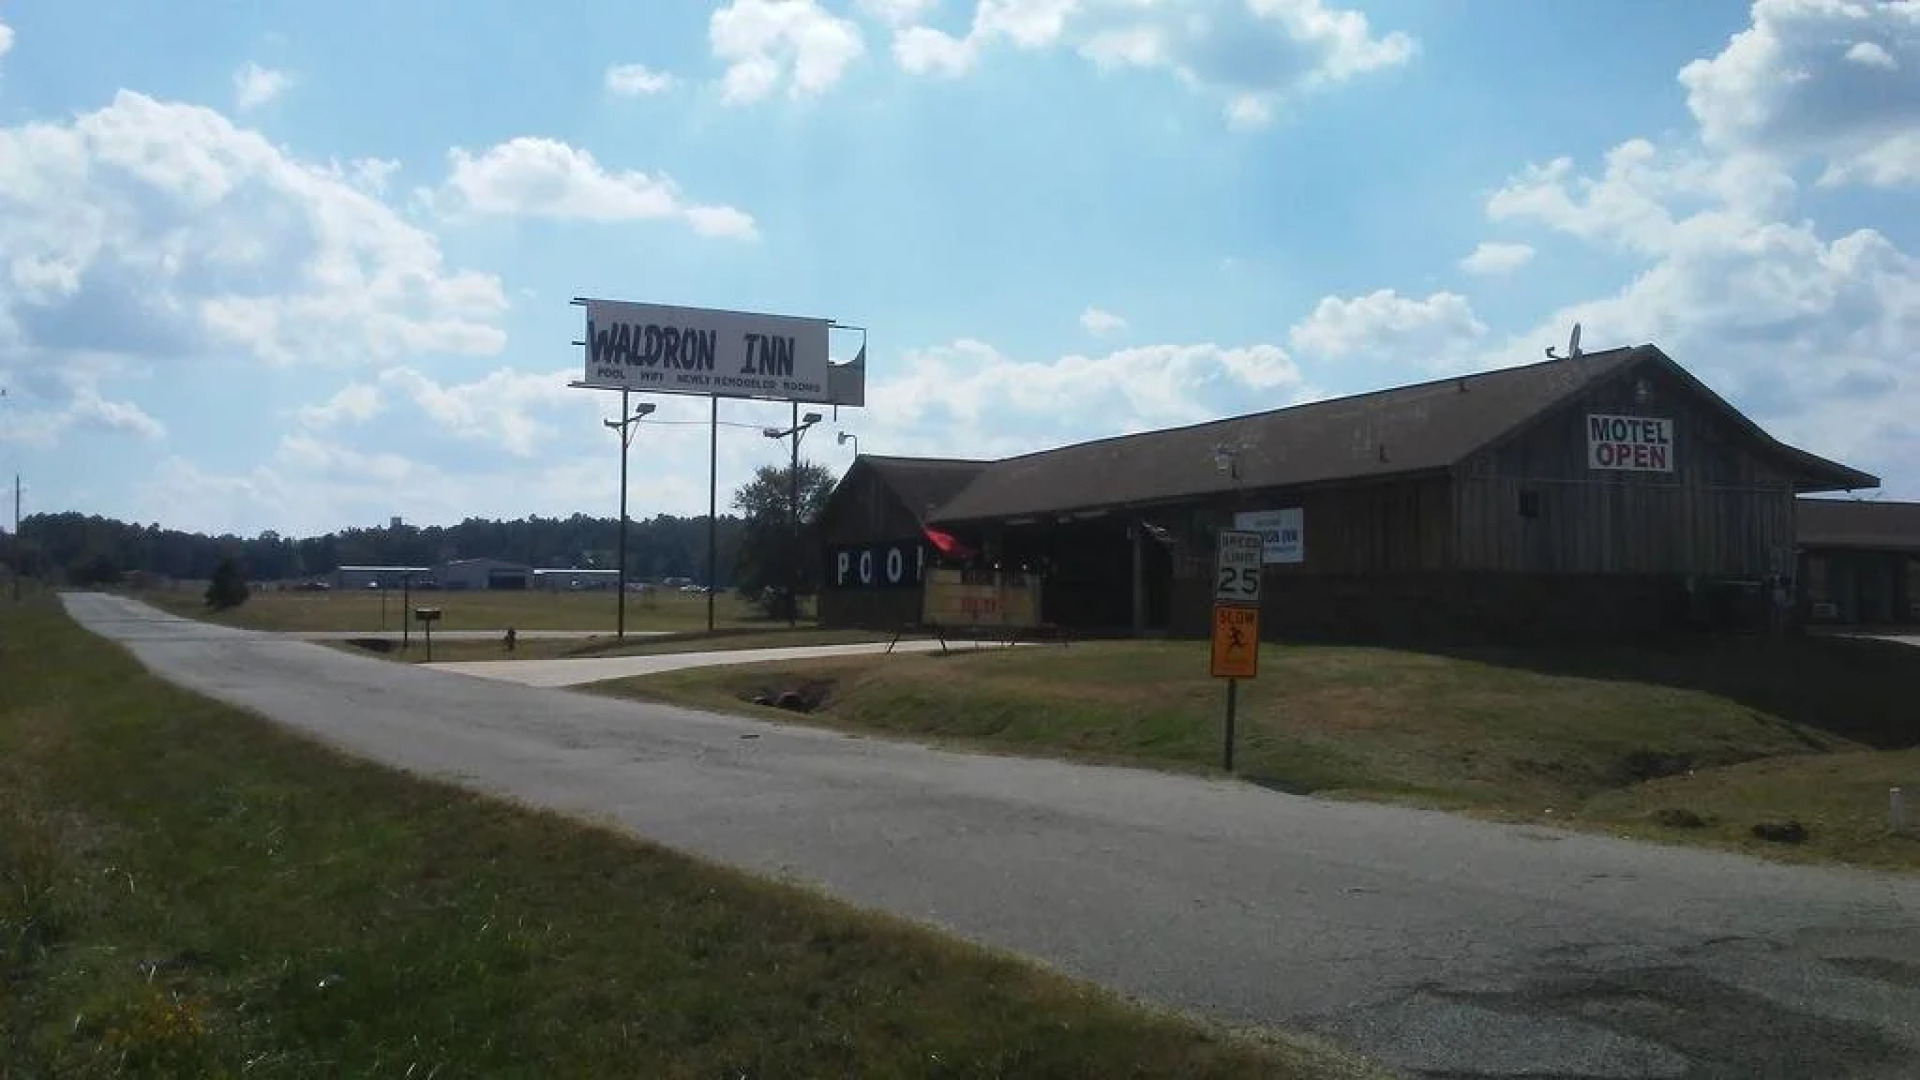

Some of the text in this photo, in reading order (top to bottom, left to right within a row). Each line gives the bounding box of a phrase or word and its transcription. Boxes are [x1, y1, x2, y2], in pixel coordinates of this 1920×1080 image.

[588, 320, 795, 377] WALDRON INN
[598, 367, 627, 380] POOL
[677, 374, 710, 386] NEWLY
[714, 376, 776, 390] REMODELED
[783, 382, 820, 393] ROOMS
[1591, 417, 1669, 444] MOTEL
[1596, 443, 1666, 468] OPEN
[1219, 568, 1258, 594] 25
[1219, 610, 1256, 626] SLOW
